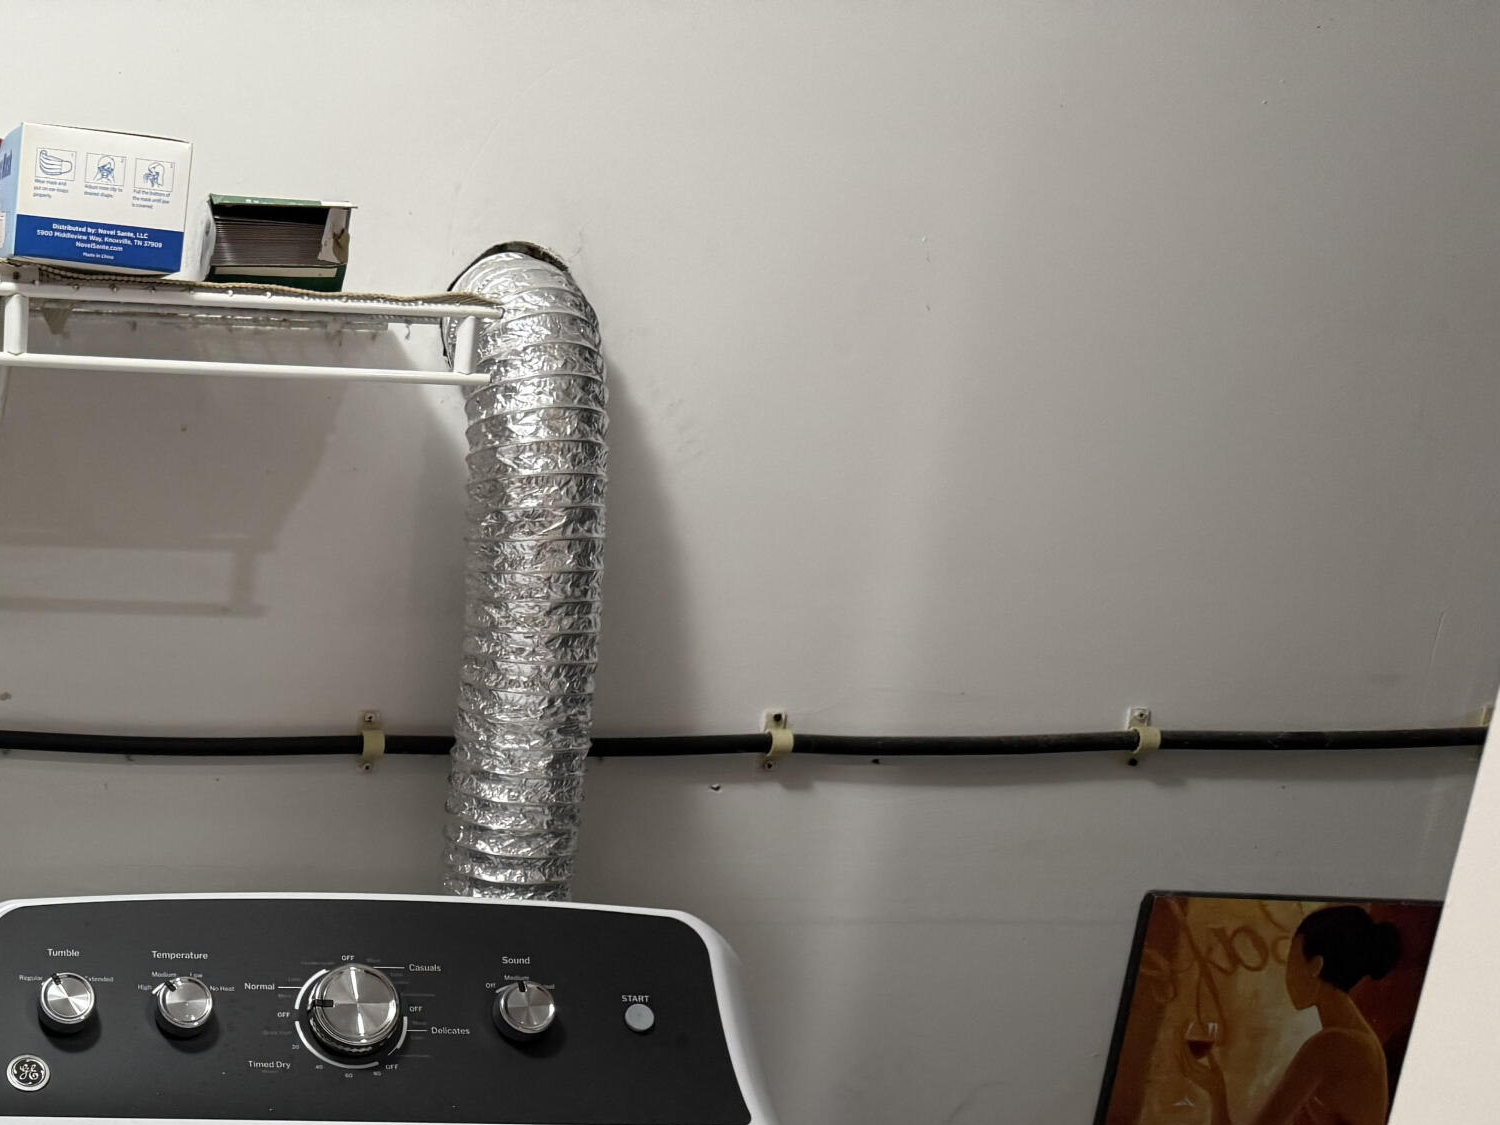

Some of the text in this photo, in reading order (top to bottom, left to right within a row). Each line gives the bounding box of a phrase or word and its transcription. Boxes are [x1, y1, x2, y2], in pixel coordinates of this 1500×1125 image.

[52, 223, 87, 232] Distributed
[98, 228, 116, 236] Novel
[117, 230, 136, 239] Sante,
[37, 229, 53, 237] 5900
[54, 232, 88, 240] Middleview
[104, 236, 133, 246] Knoxville,
[143, 240, 163, 249] 37909
[75, 241, 124, 251] NovelSante.com
[47, 948, 80, 957] Tumble
[151, 951, 209, 961] Temperature
[501, 956, 531, 965] Sound
[408, 963, 441, 972] Casuals
[18, 974, 43, 982] Regular
[244, 982, 275, 990] Normal
[621, 994, 649, 1003] START
[431, 1026, 470, 1035] Delicates
[248, 1060, 291, 1069] Timed Dry
